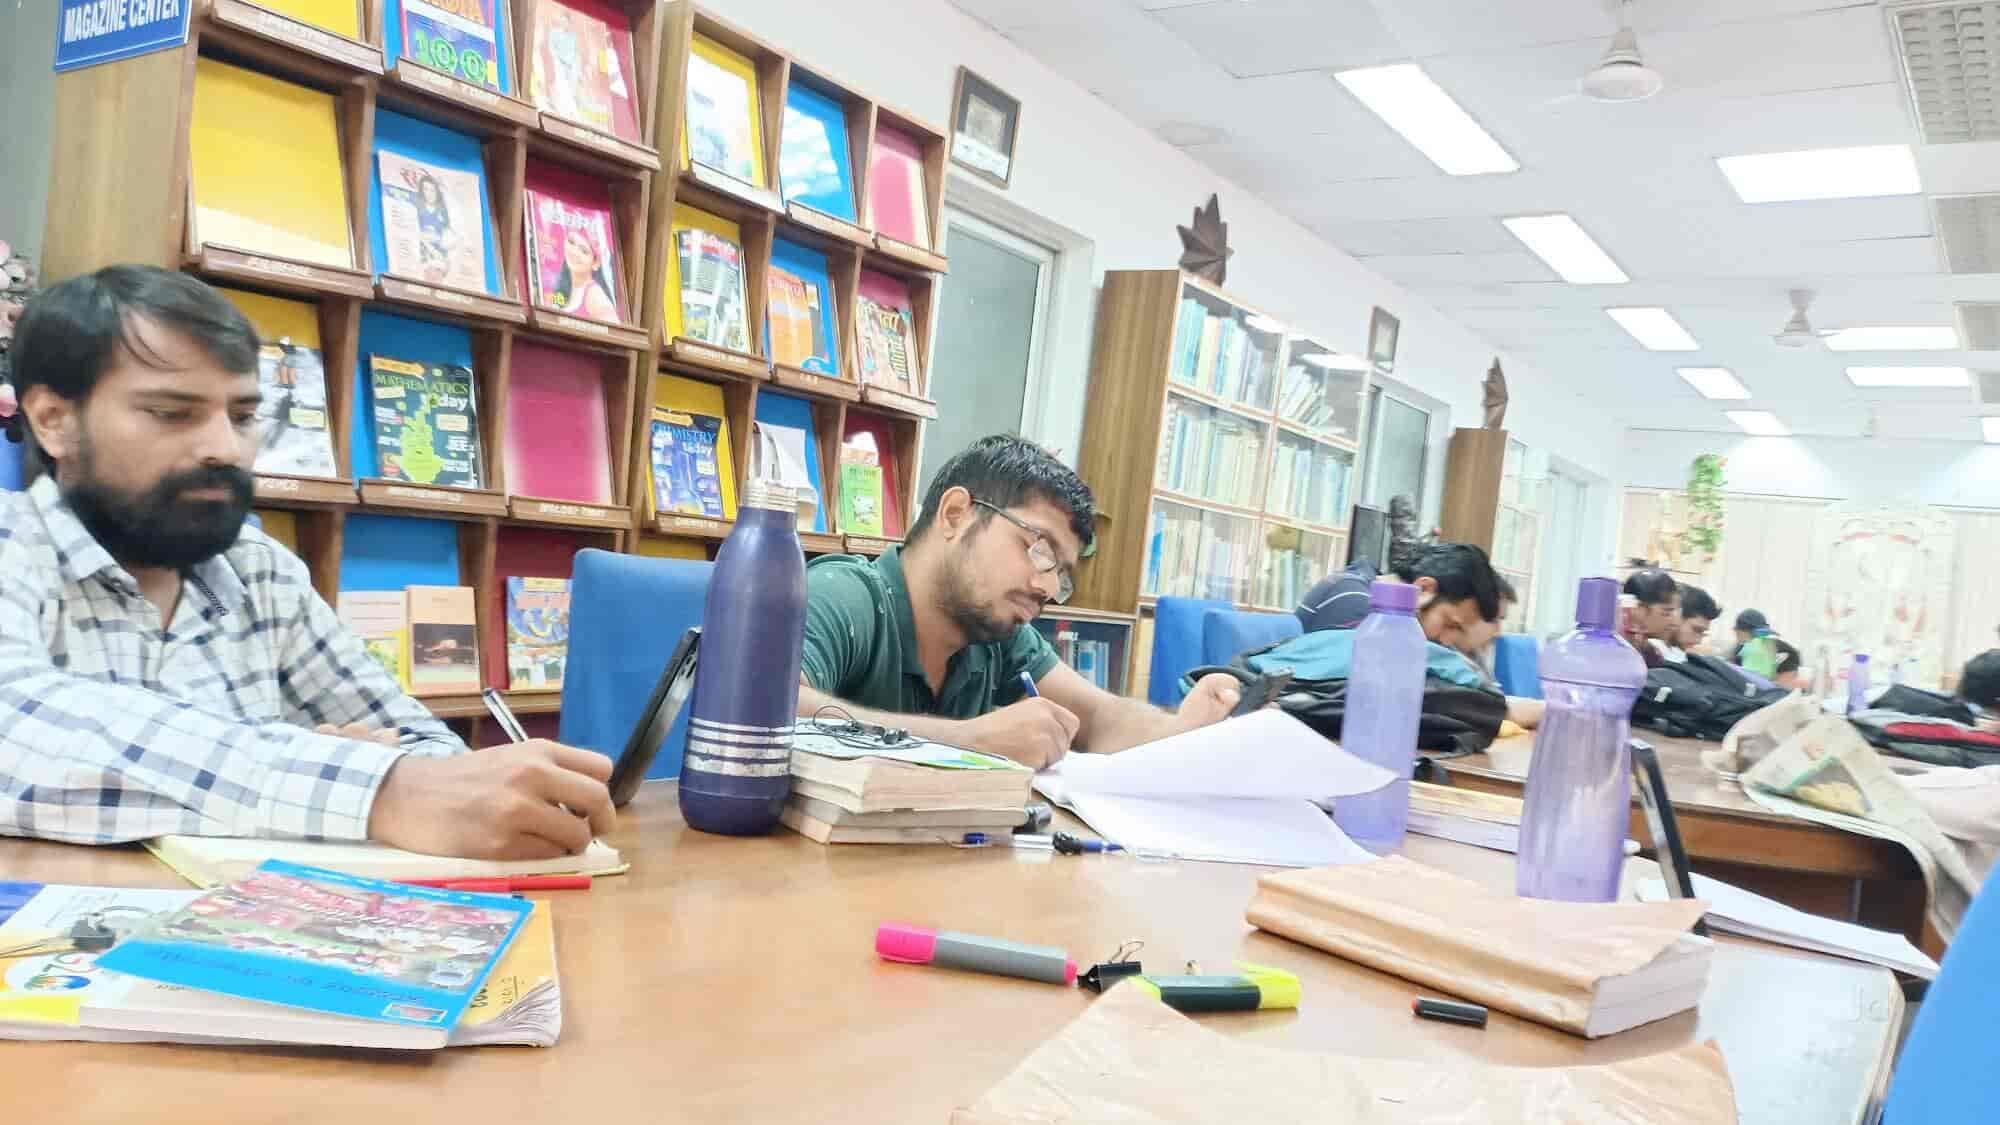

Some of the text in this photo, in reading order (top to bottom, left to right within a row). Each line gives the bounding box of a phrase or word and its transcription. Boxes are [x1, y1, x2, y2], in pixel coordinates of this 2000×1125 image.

[64, 0, 127, 43] MAGAZINE
[414, 28, 487, 82] 100
[375, 373, 469, 394] MATHEMATICS
